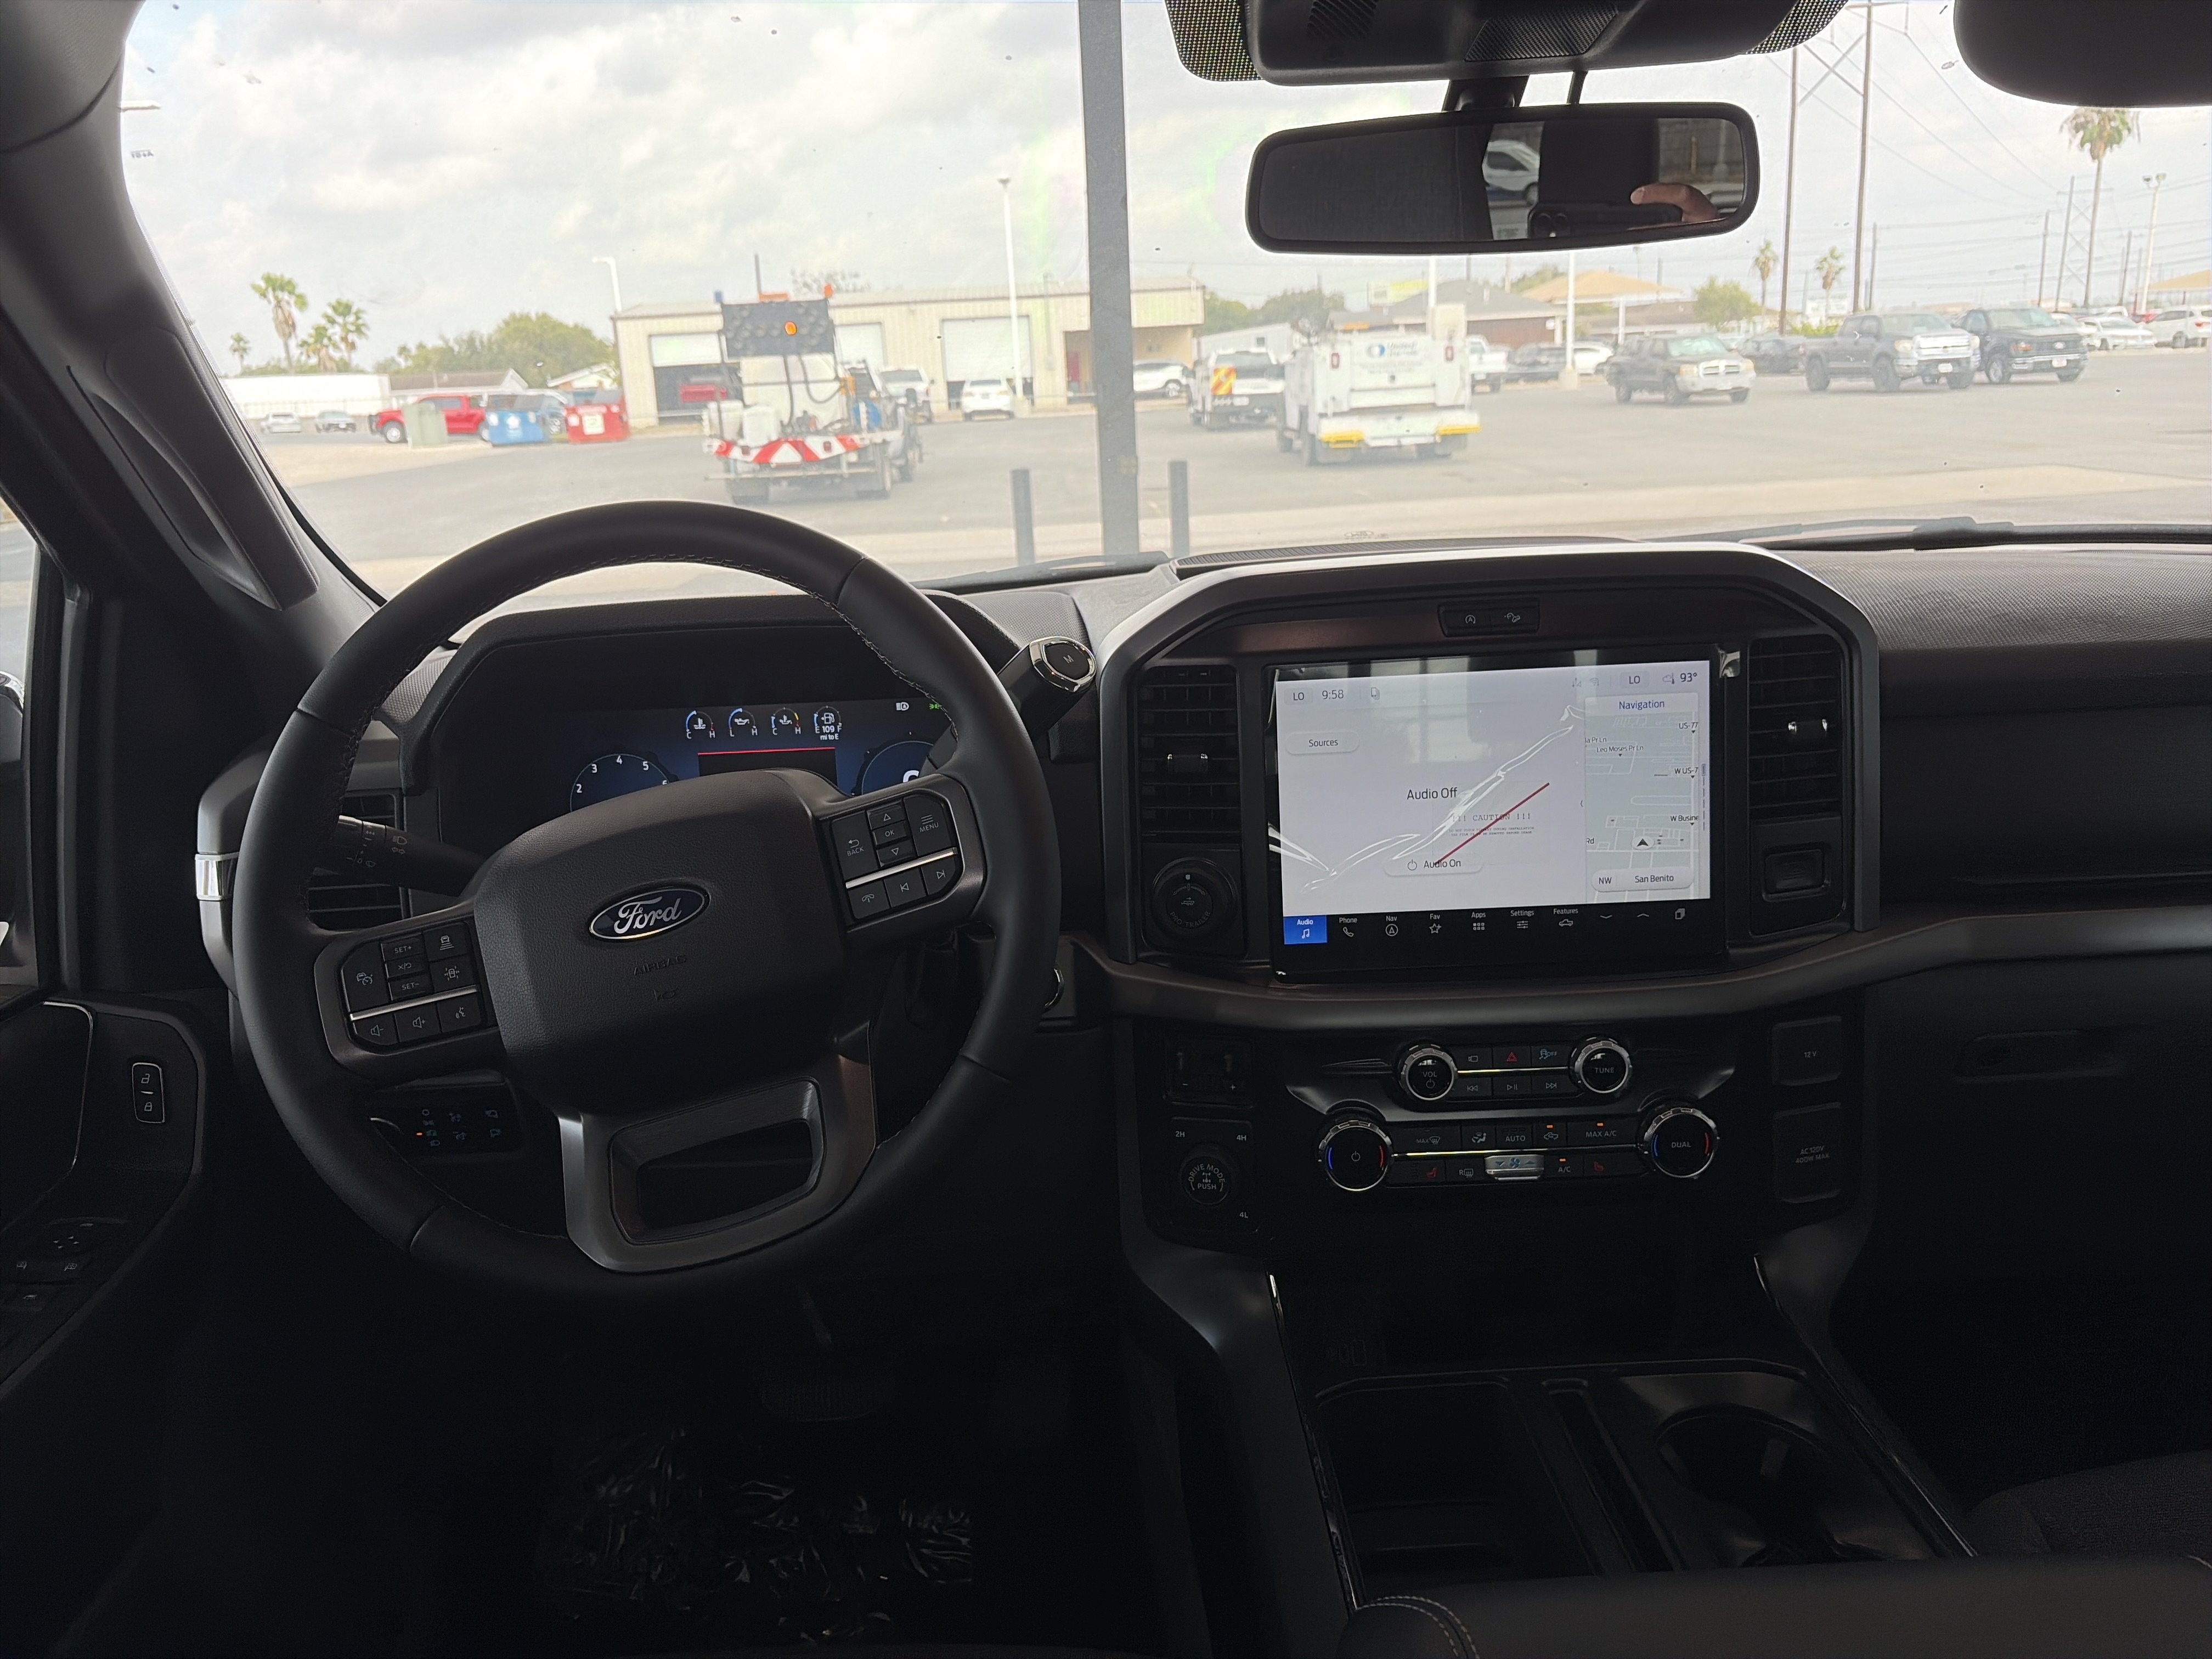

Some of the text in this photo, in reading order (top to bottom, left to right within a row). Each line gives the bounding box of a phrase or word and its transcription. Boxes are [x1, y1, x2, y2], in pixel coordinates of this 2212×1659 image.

[1063, 654, 1075, 664] M
[1629, 675, 1640, 685] LO
[1680, 672, 1698, 682] 93°
[1293, 692, 1305, 701] LO
[1322, 689, 1344, 699] 9:58
[1619, 701, 1664, 710] Navigation
[1308, 739, 1338, 747] Sources
[616, 755, 623, 764] 4
[591, 764, 597, 773] 3
[642, 761, 649, 771] 5
[576, 783, 582, 793] 2
[1407, 787, 1458, 800] Audio Off
[919, 822, 939, 833] MENU
[847, 847, 865, 856] BACK
[1424, 859, 1461, 868] Audio On
[614, 896, 682, 934] Ford
[1170, 911, 1211, 928] PRO TRAILER
[1505, 1135, 1526, 1143] AUTO
[1188, 1163, 1226, 1183] DRIVE MODE
